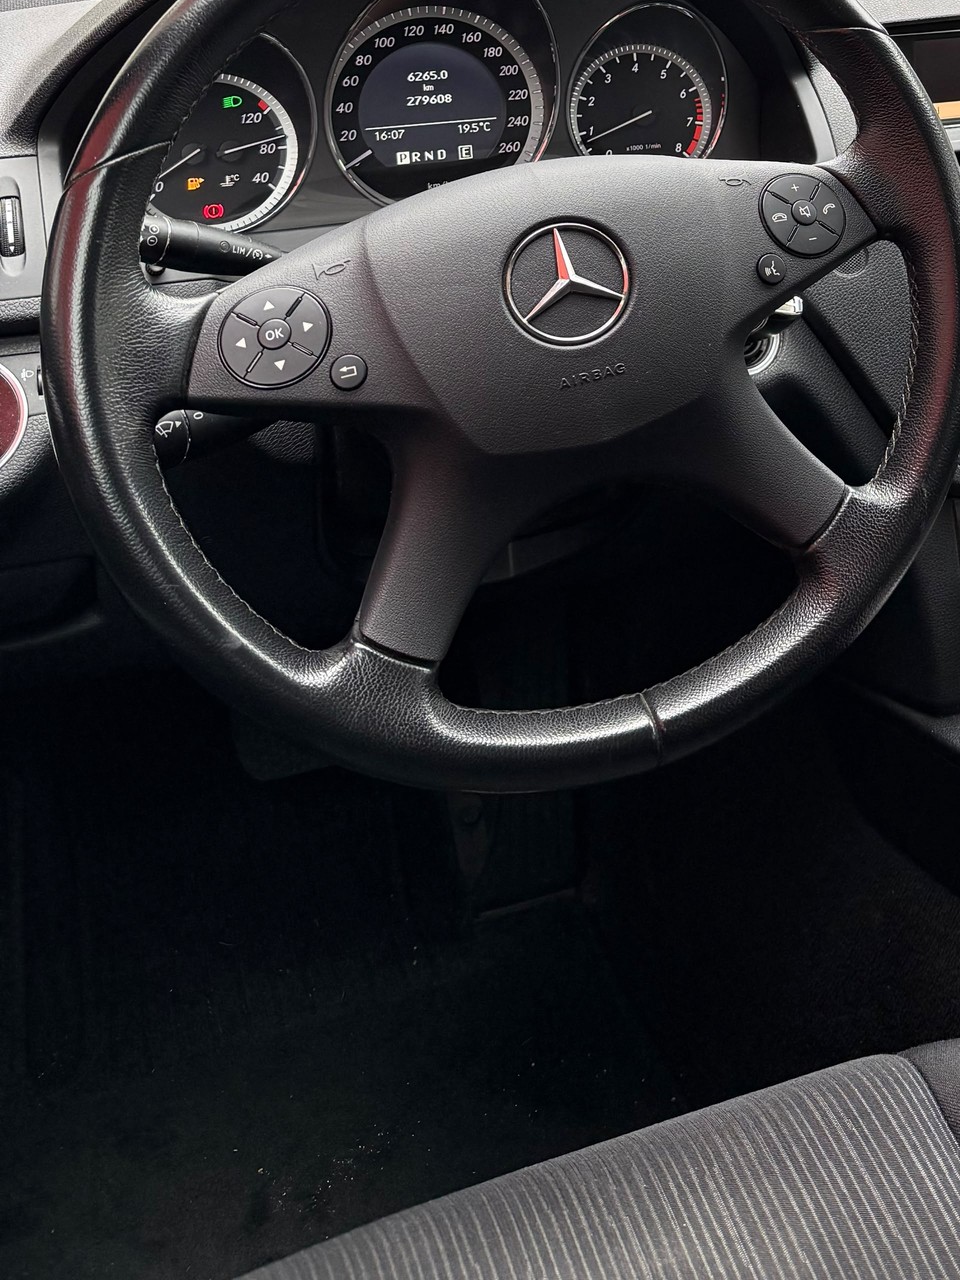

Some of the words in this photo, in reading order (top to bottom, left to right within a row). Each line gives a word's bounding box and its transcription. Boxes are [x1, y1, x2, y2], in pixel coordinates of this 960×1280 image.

[404, 26, 424, 36] 120
[434, 24, 454, 35] 140
[374, 37, 395, 48] 100
[462, 32, 481, 43] 160
[484, 47, 502, 58] 180
[356, 55, 372, 66] 80
[499, 65, 518, 76] 200
[632, 63, 639, 72] 4
[407, 70, 448, 82] 6265.0
[605, 75, 611, 83] 3
[660, 70, 667, 79] 5
[342, 76, 359, 86] 60
[508, 89, 528, 100] 220
[680, 90, 686, 98] 6
[407, 94, 452, 106] 279608
[588, 97, 595, 106] 2
[336, 102, 353, 113] 40
[241, 112, 261, 124] 120
[507, 116, 528, 127] 240
[686, 118, 693, 126] 7
[458, 122, 490, 133] 19.5°C
[589, 127, 594, 135] 1
[340, 130, 356, 141] 20
[375, 130, 405, 141] 16:07
[259, 143, 275, 154] 80
[499, 142, 520, 153] 260
[676, 143, 682, 152] 8
[400, 153, 407, 164] P
[412, 152, 420, 162] R
[424, 150, 434, 160] N
[438, 150, 446, 159] D
[462, 148, 469, 157] E
[252, 172, 269, 183] 40
[155, 182, 163, 192] 0
[265, 328, 284, 340] OK
[560, 363, 626, 389] AIRBAG
